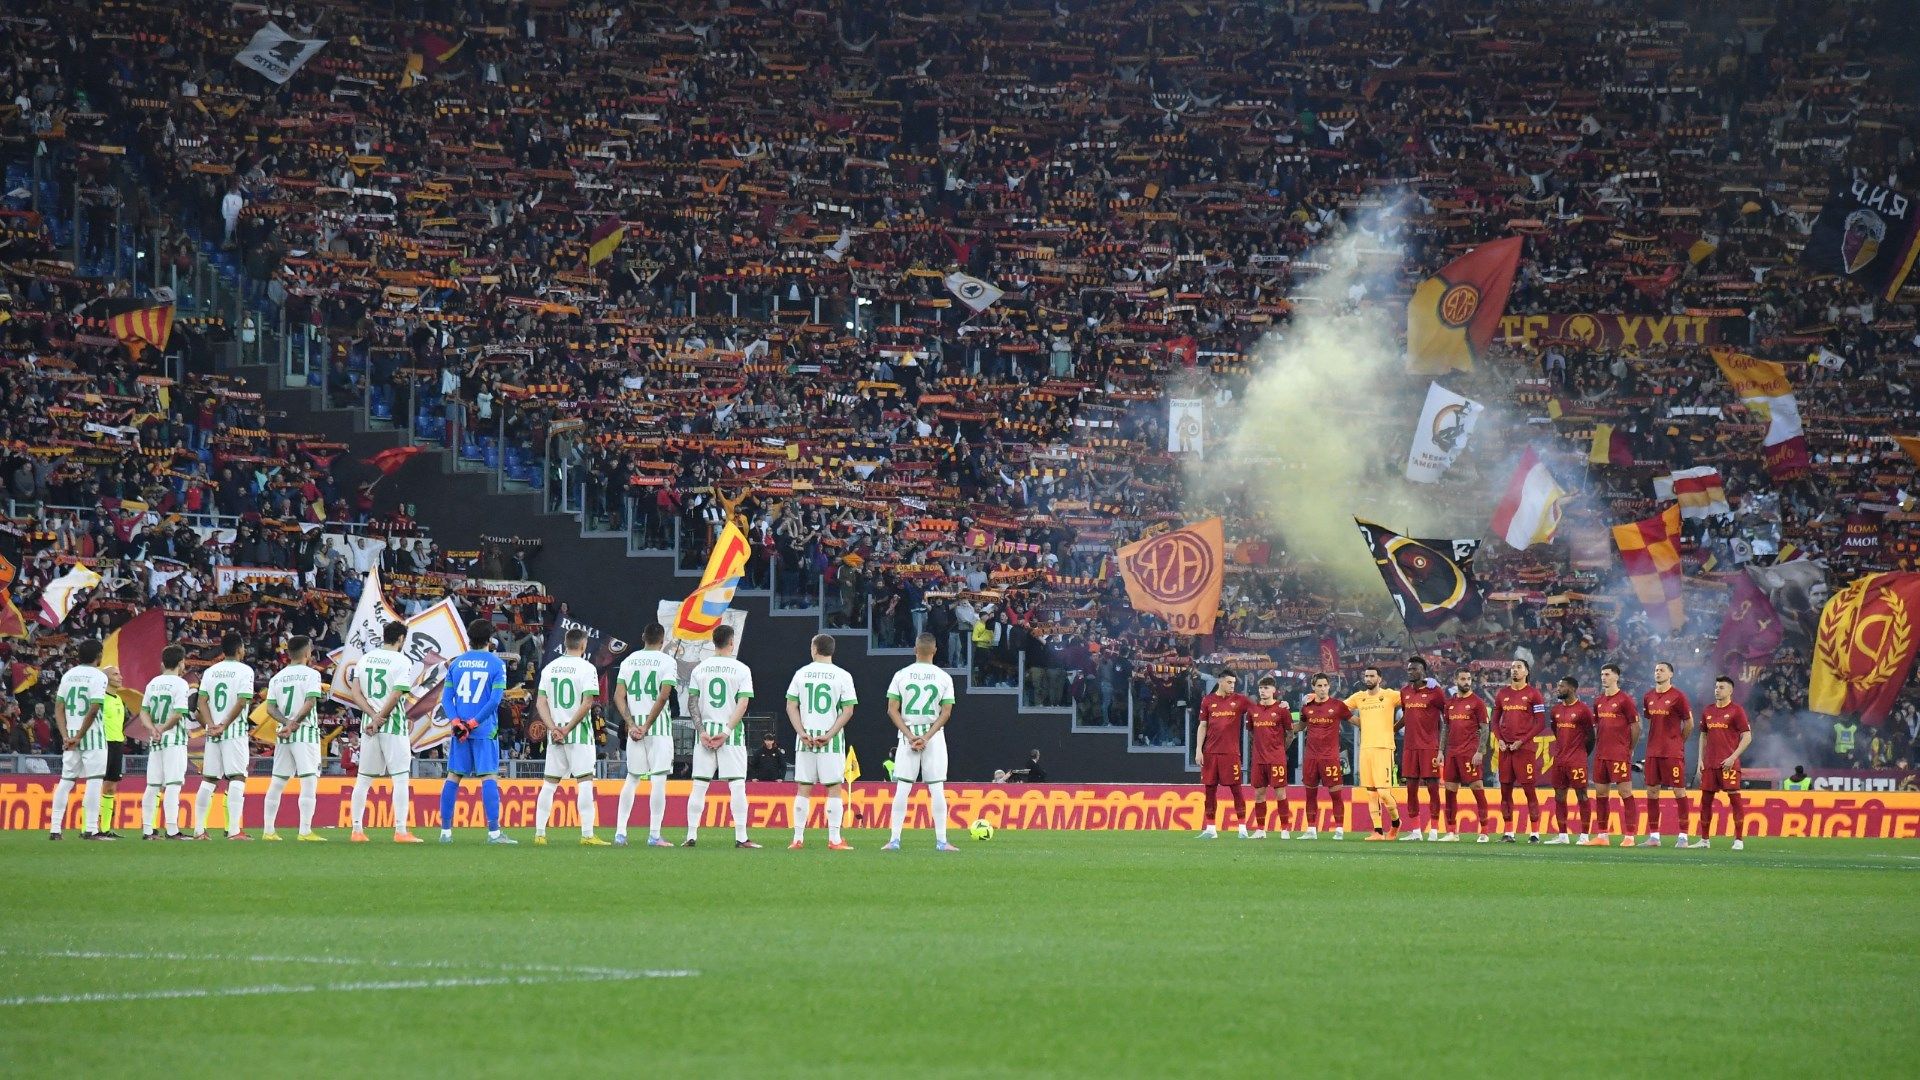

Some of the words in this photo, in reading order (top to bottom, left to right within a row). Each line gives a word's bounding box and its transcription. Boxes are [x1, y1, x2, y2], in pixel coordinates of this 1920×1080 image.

[1847, 523, 1878, 533] ROMA
[1845, 537, 1878, 547] AMOR
[560, 617, 601, 639] ROMA
[458, 659, 488, 669] CONSIGLI
[365, 667, 387, 699] 13
[457, 671, 489, 704] 47
[627, 670, 658, 702] 44
[909, 672, 936, 681] TOLJAN
[65, 686, 89, 717] 45
[214, 682, 228, 712] 6
[283, 685, 295, 717] 7
[550, 677, 575, 710] 10
[708, 677, 727, 708] 9
[804, 683, 832, 714] 16
[905, 683, 939, 715] 22
[150, 695, 172, 724] 27
[1233, 765, 1239, 775] 3
[1272, 765, 1285, 776] 59
[1325, 765, 1338, 776] 52
[1526, 763, 1533, 774] 6
[1572, 767, 1585, 779] 25
[1613, 762, 1627, 773] 24
[1673, 766, 1679, 777] 8
[1722, 769, 1736, 780] 92
[977, 803, 1194, 831] CHAMPIONS
